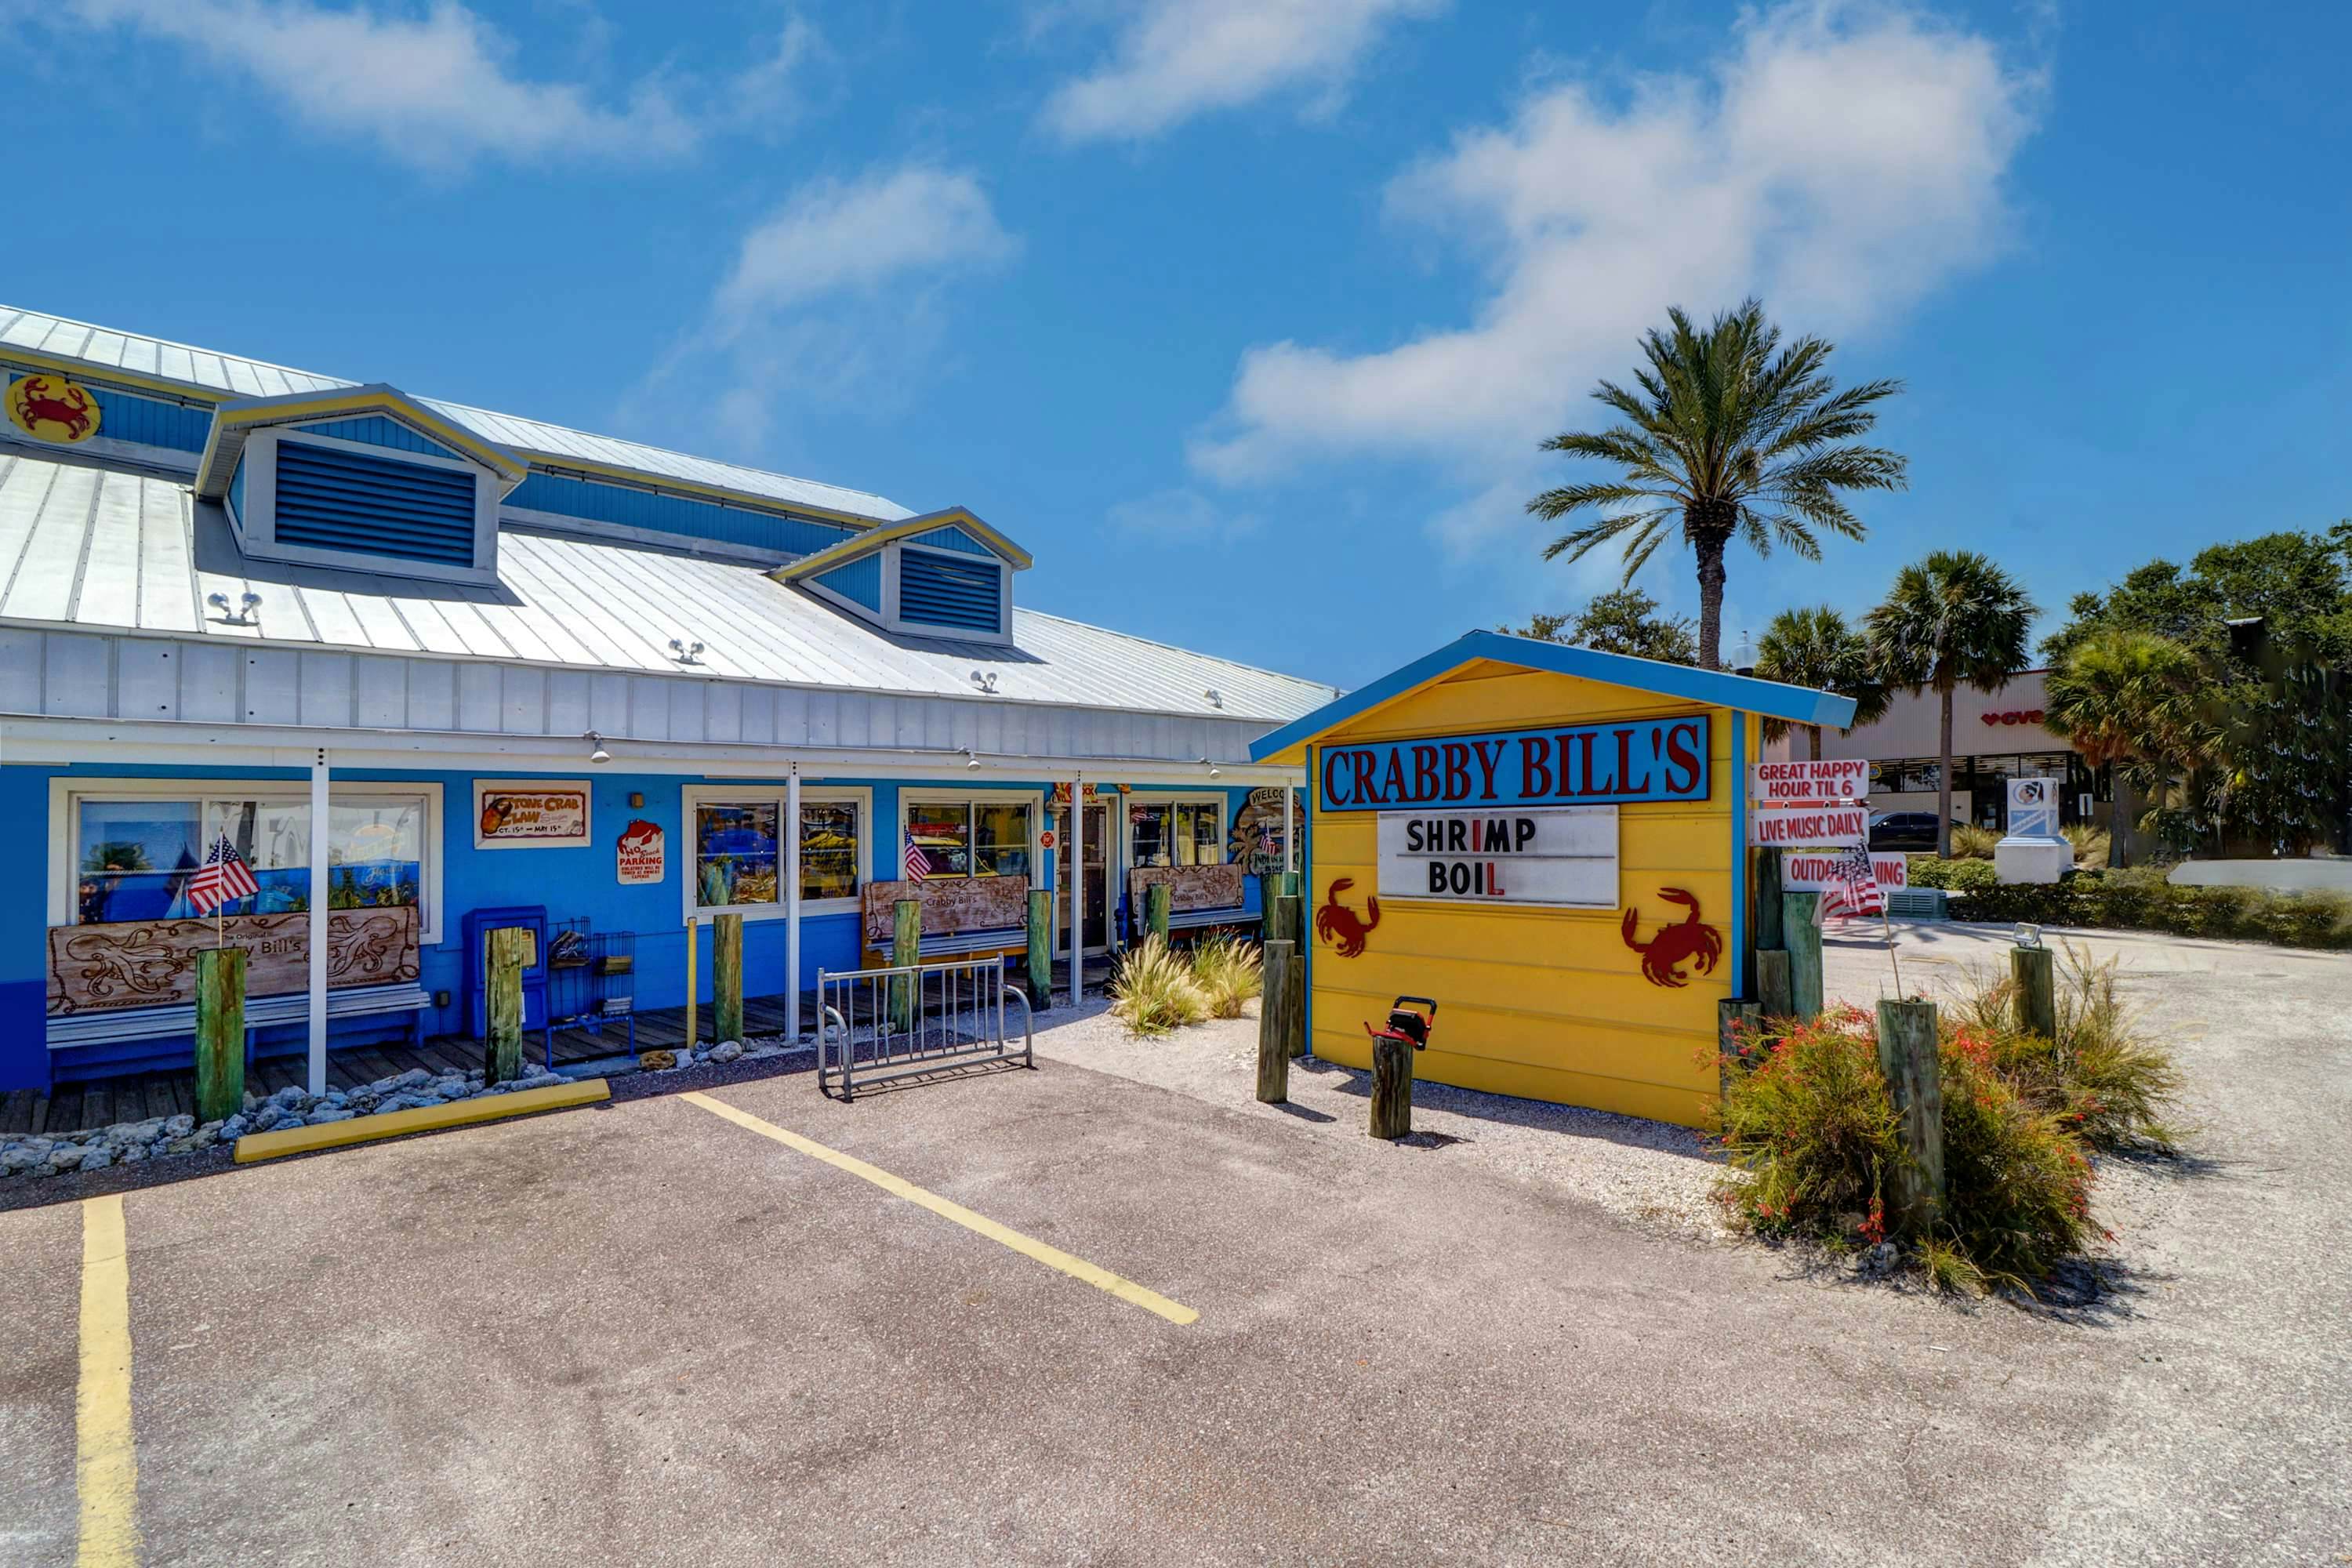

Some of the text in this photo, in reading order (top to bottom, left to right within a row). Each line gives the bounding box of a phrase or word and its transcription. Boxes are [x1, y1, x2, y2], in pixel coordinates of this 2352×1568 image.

[2002, 710, 2045, 725] CVS
[1325, 723, 1700, 806] CRABBY BILL'S
[1759, 764, 1806, 781] GREAT
[1809, 761, 1865, 779] HAPPY
[1769, 779, 1853, 797] HOUR TIL 6
[544, 797, 579, 811] CRAB
[1252, 789, 1299, 804] WELCOE
[1759, 811, 1864, 842] LIVE MUSIC DAILY
[1406, 818, 1536, 853] SHRIMP
[626, 846, 641, 857] NO
[619, 857, 662, 866] PARKING
[1428, 862, 1504, 896] BOIL
[1791, 858, 1904, 885] OUTDO NING
[926, 895, 977, 907] Crabby Bill's
[261, 941, 301, 954] Bill's
